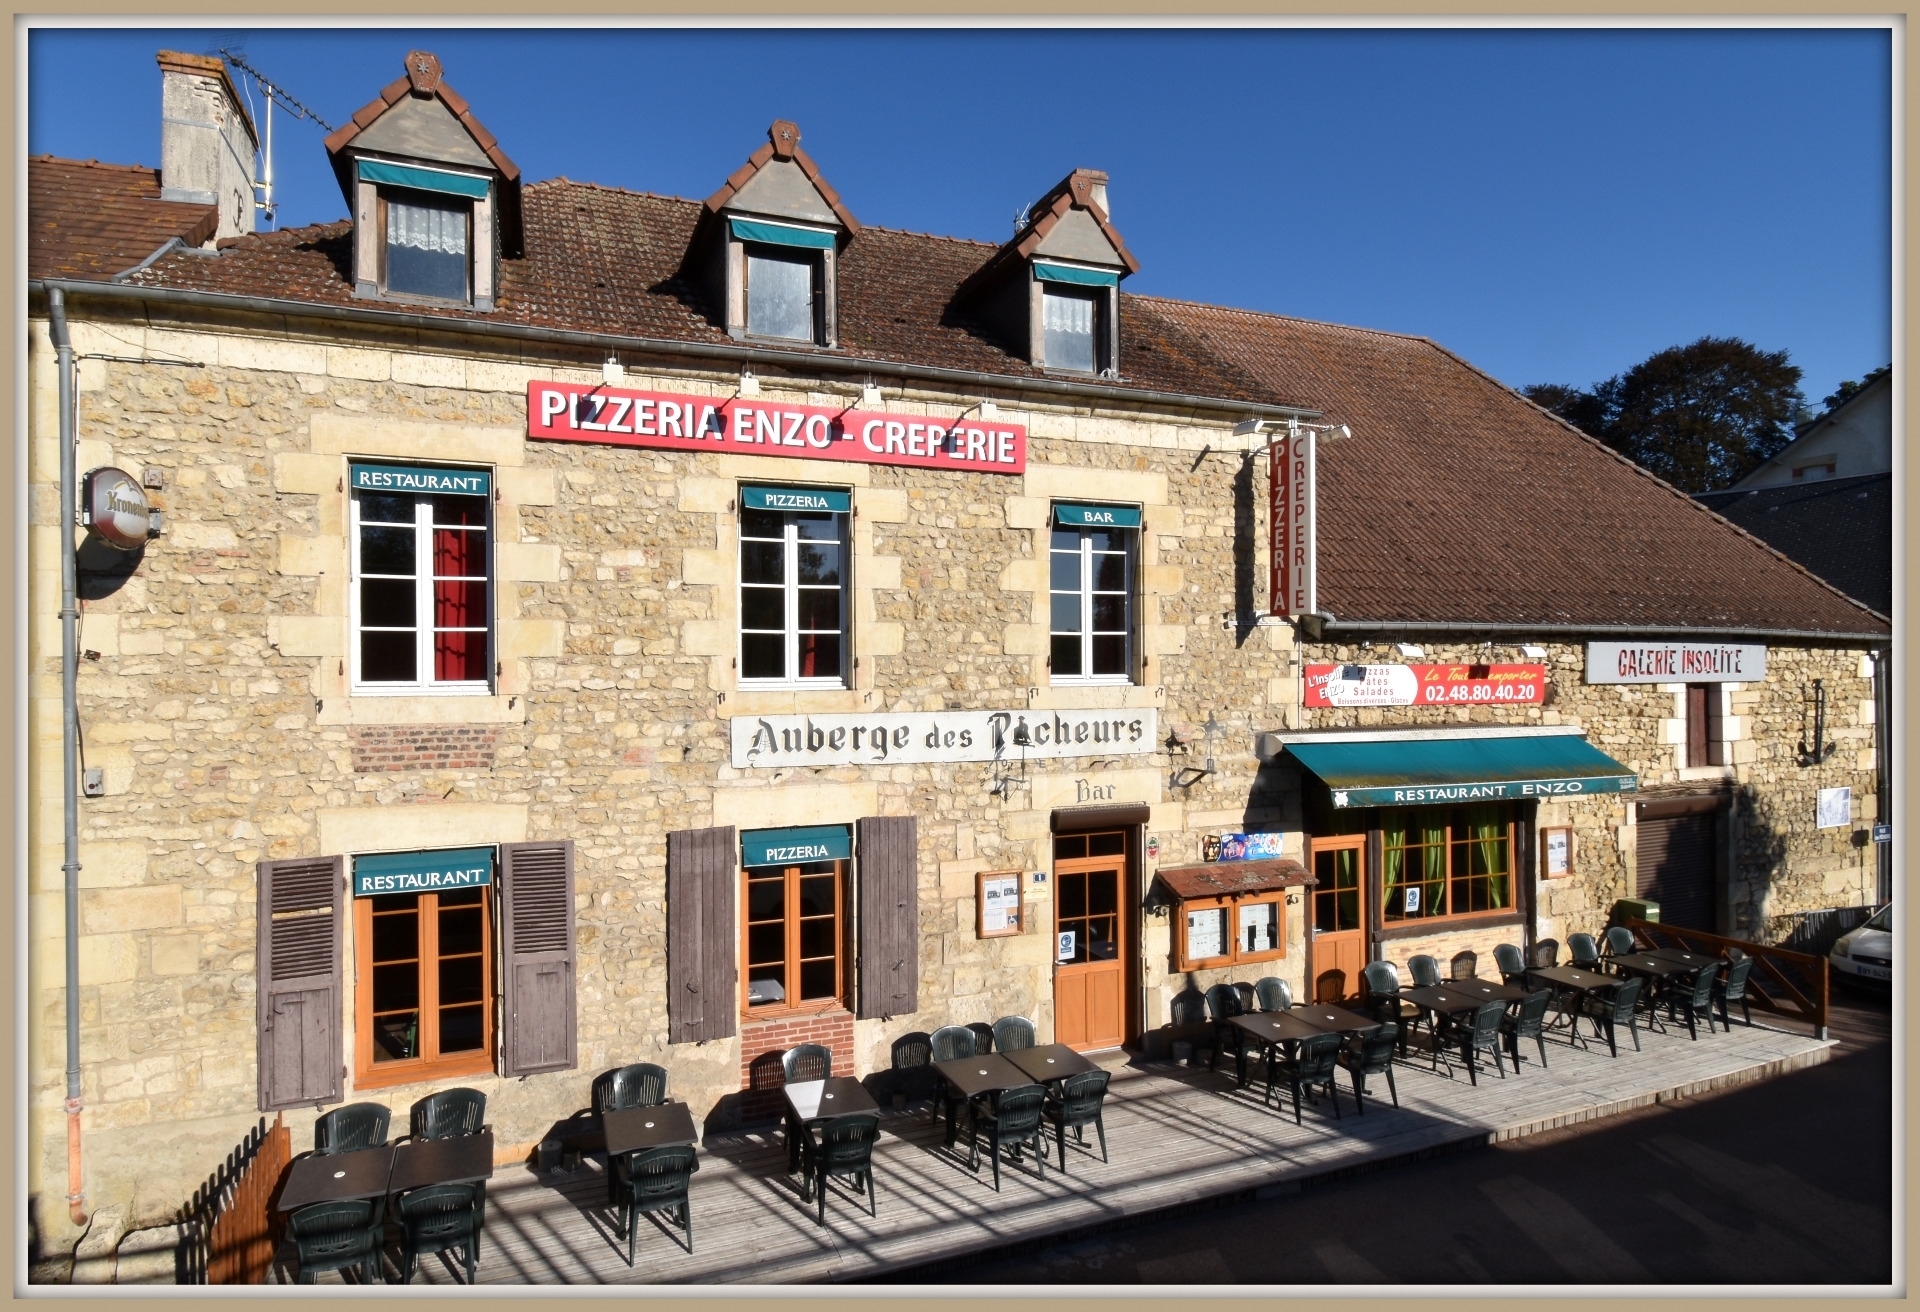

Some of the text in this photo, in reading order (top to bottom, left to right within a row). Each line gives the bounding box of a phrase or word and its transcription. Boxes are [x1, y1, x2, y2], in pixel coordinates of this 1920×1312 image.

[541, 390, 724, 440] PIZZERIA
[733, 406, 832, 448] ENZO
[862, 419, 1015, 463] CREPERIE
[360, 471, 482, 491] RESTAURANT
[765, 494, 829, 508] PIZZERIA
[1084, 511, 1114, 522] BAR
[1293, 438, 1305, 609] CREPERIE
[1274, 443, 1286, 611] PIZZERIA
[1618, 645, 1742, 677] GALERIE INSOLITE
[1424, 668, 1440, 681] Le
[1447, 667, 1470, 682] Tout
[1487, 670, 1537, 685] emporter
[1354, 687, 1394, 696] Salades
[1425, 684, 1535, 702] 02.48.80.40.20
[747, 711, 1143, 761] Auberge des Pcheurs
[1075, 778, 1116, 803] Bar
[1395, 782, 1583, 801] RESTAURANT ENZO
[766, 845, 828, 861] PIZZERIA
[362, 869, 484, 890] RESTAURANT
